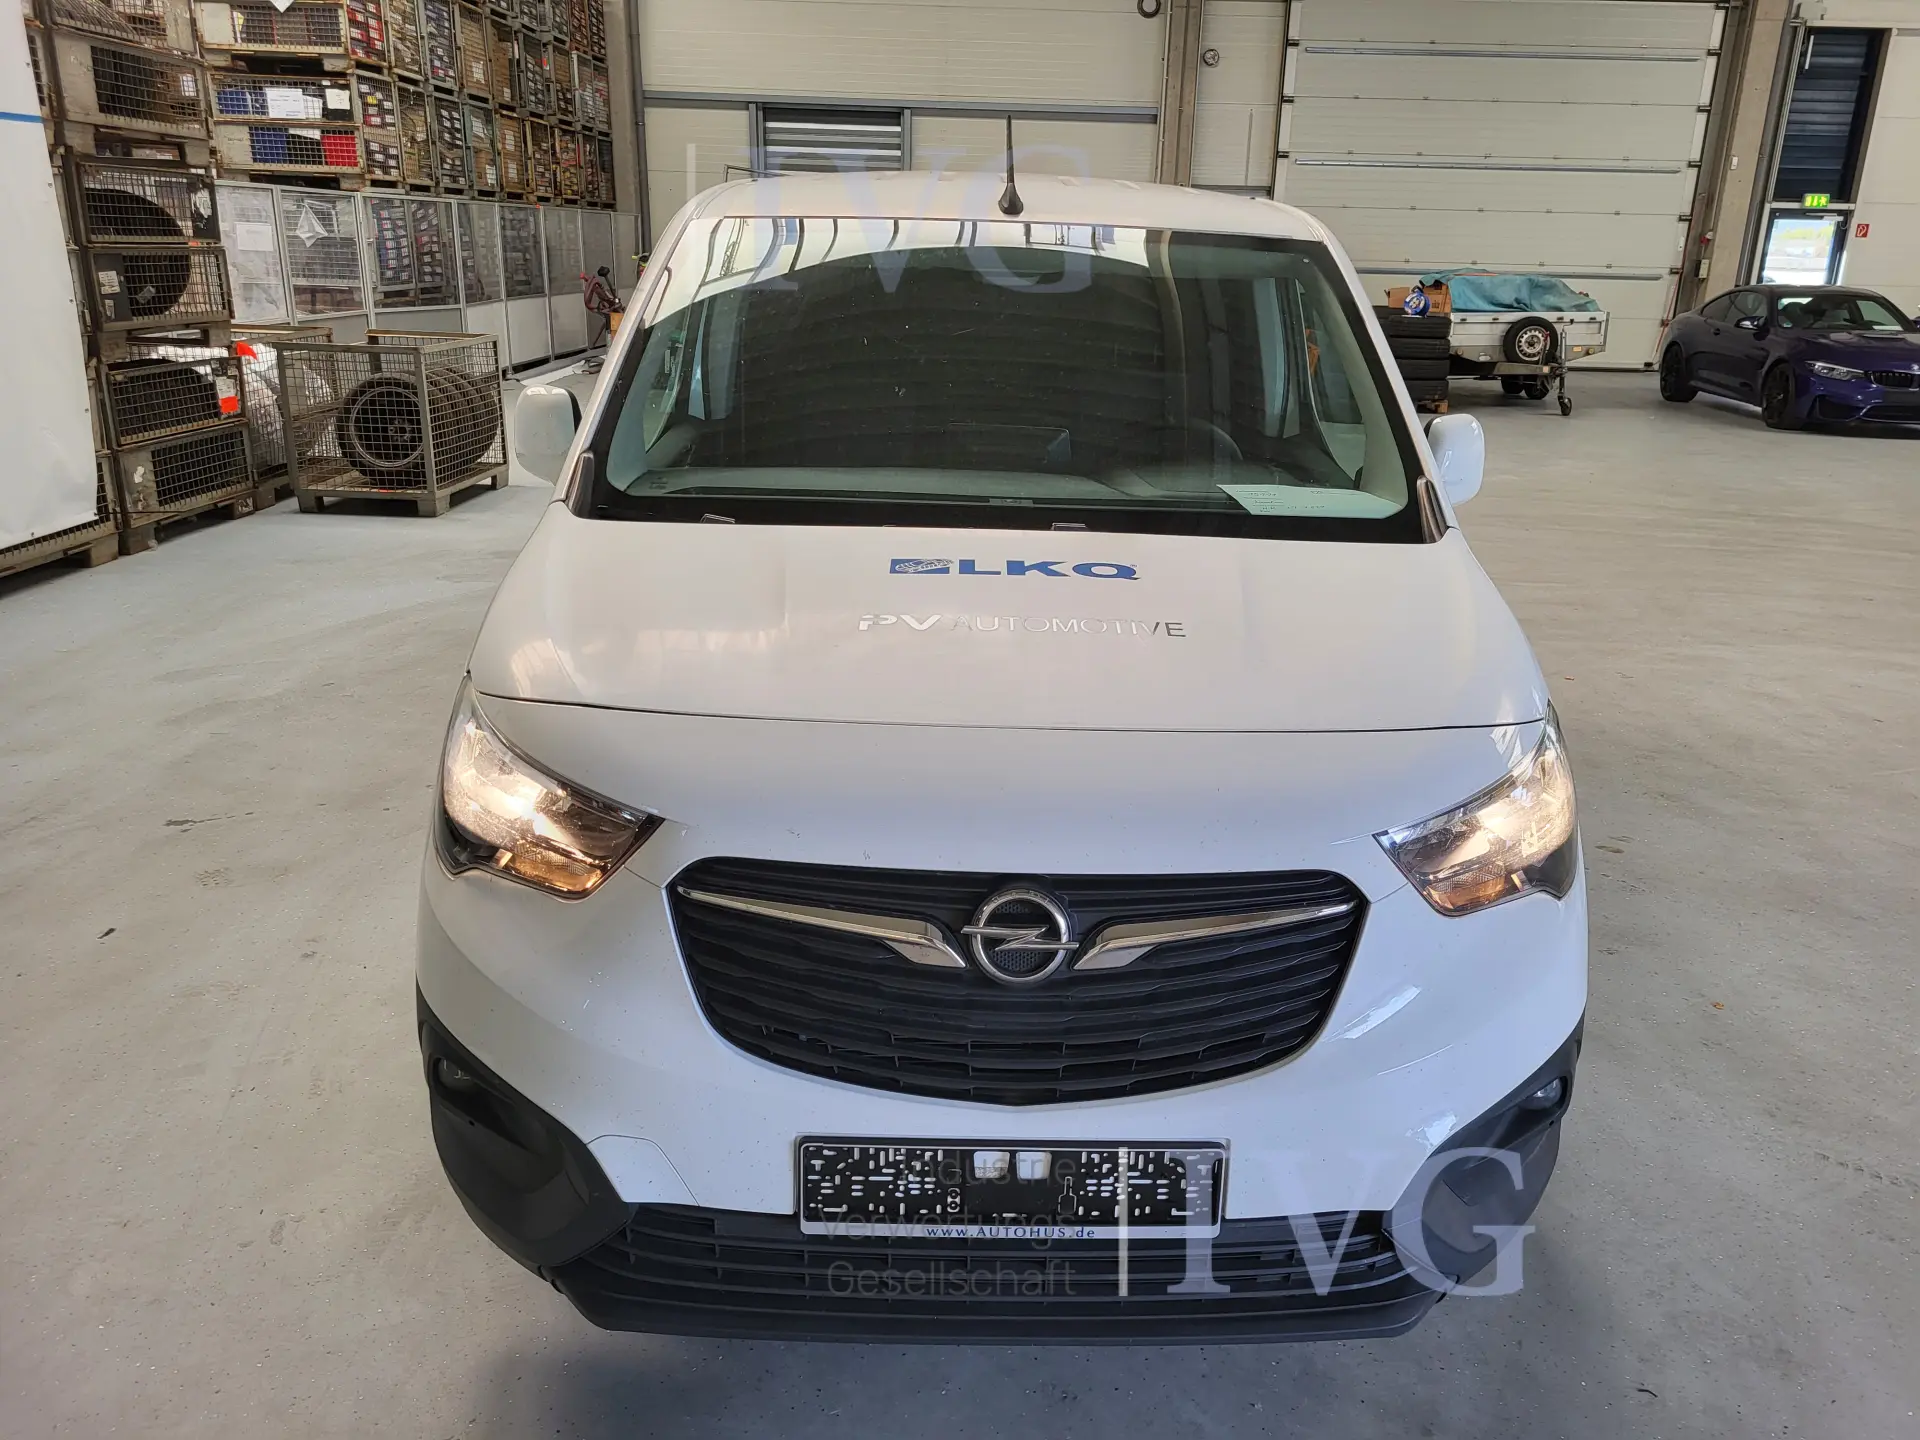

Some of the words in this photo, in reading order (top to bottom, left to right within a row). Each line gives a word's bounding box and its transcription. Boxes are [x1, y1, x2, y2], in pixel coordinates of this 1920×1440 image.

[958, 559, 1140, 581] LKQ
[857, 613, 942, 631] PV
[950, 614, 1186, 637] AUTOMOTIVE
[926, 1226, 1096, 1239] www.AUTOHUS.de
